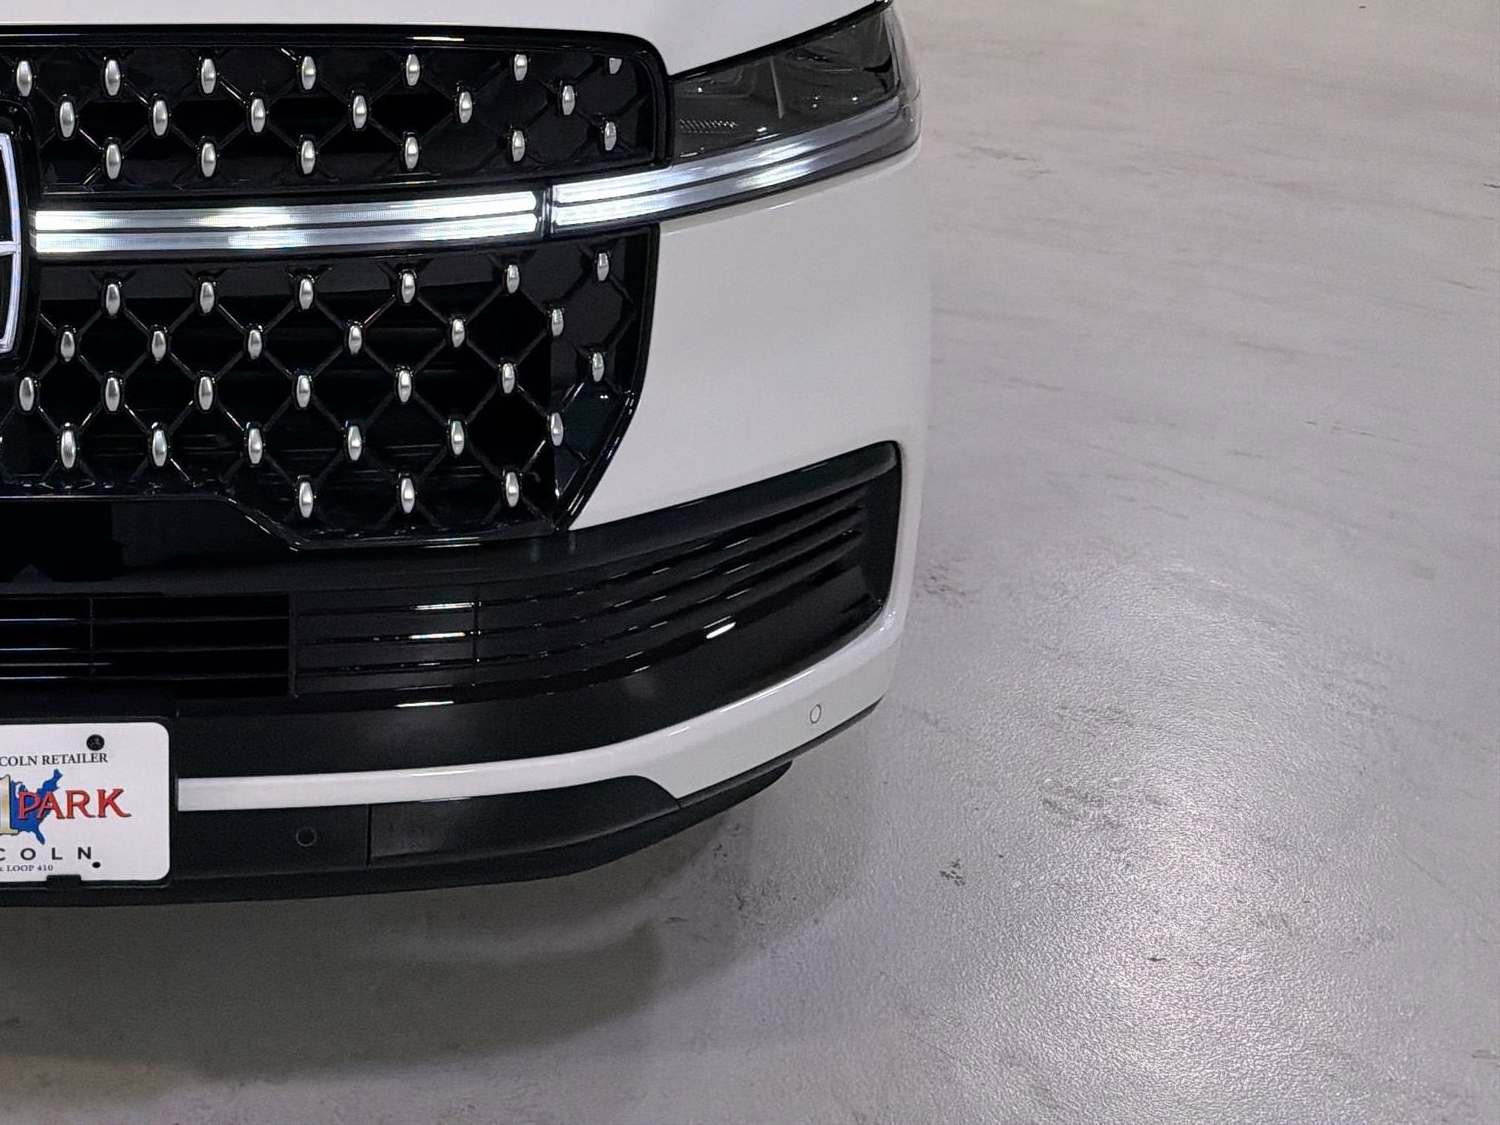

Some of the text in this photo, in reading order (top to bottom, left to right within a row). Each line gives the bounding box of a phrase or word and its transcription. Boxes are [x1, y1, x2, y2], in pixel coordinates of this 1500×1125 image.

[42, 752, 109, 765] RETAILER
[18, 788, 132, 821] PARK
[6, 864, 35, 872] LOOP
